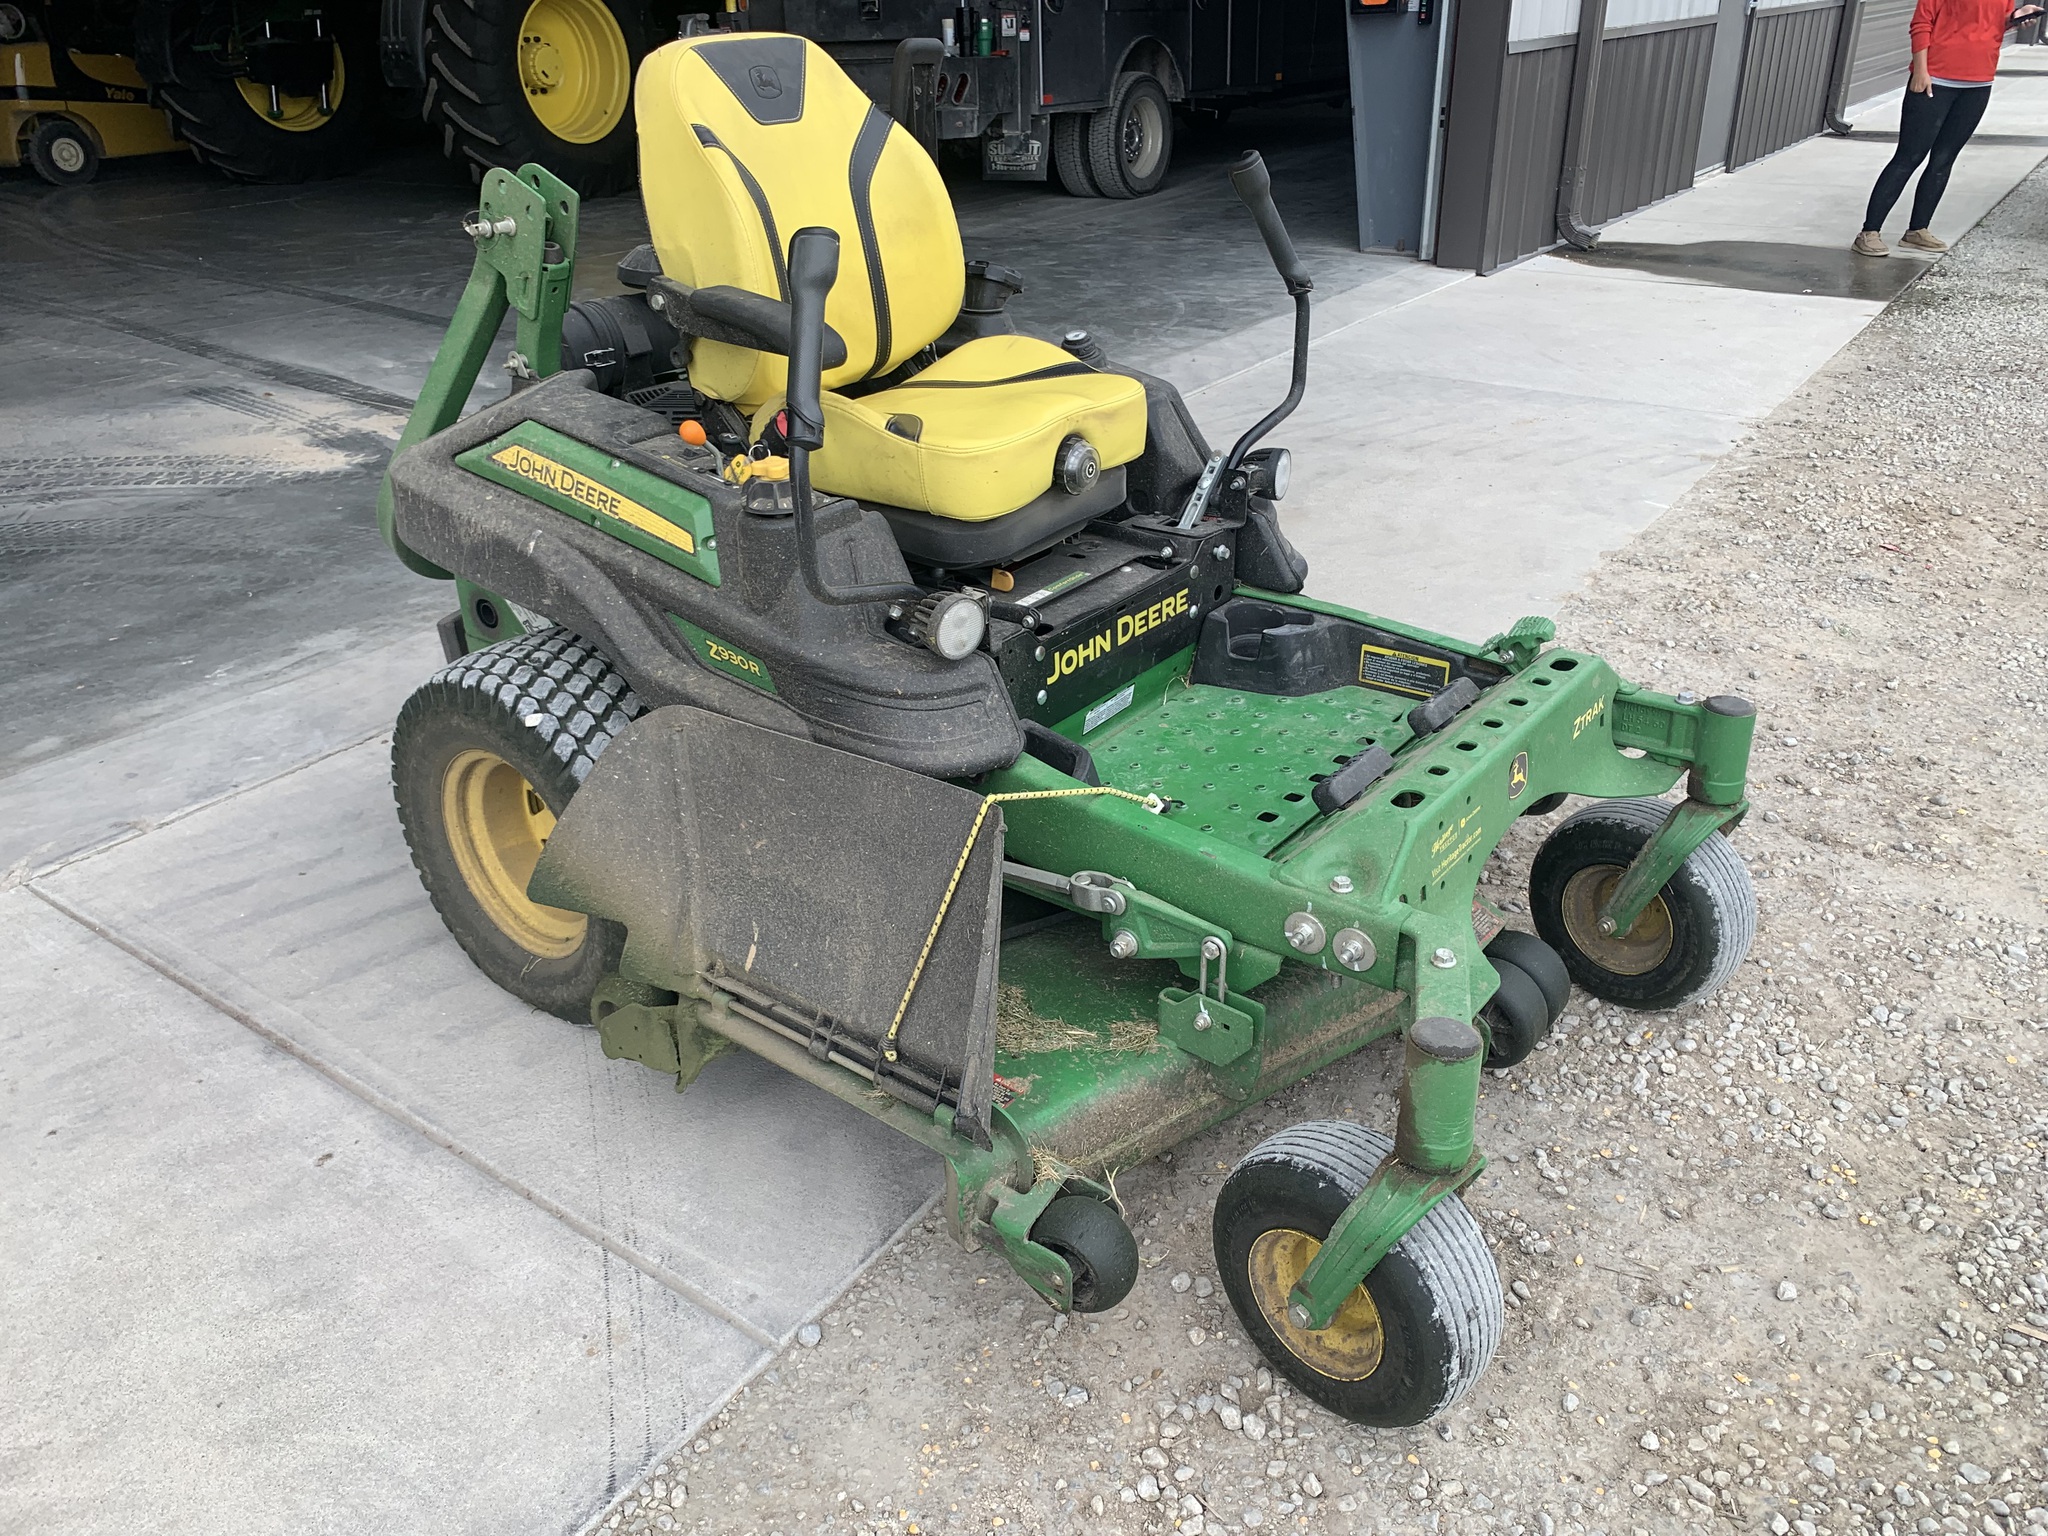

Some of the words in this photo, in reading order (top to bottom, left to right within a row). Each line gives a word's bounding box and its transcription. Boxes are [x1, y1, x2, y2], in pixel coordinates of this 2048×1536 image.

[105, 86, 135, 101] Yale
[509, 450, 556, 487] JOHN
[560, 471, 622, 517] DEERE
[705, 639, 761, 676] Z930R
[1046, 629, 1111, 685] JOHN
[1117, 587, 1189, 646] DEERE
[1572, 694, 1605, 740] ZTRAK
